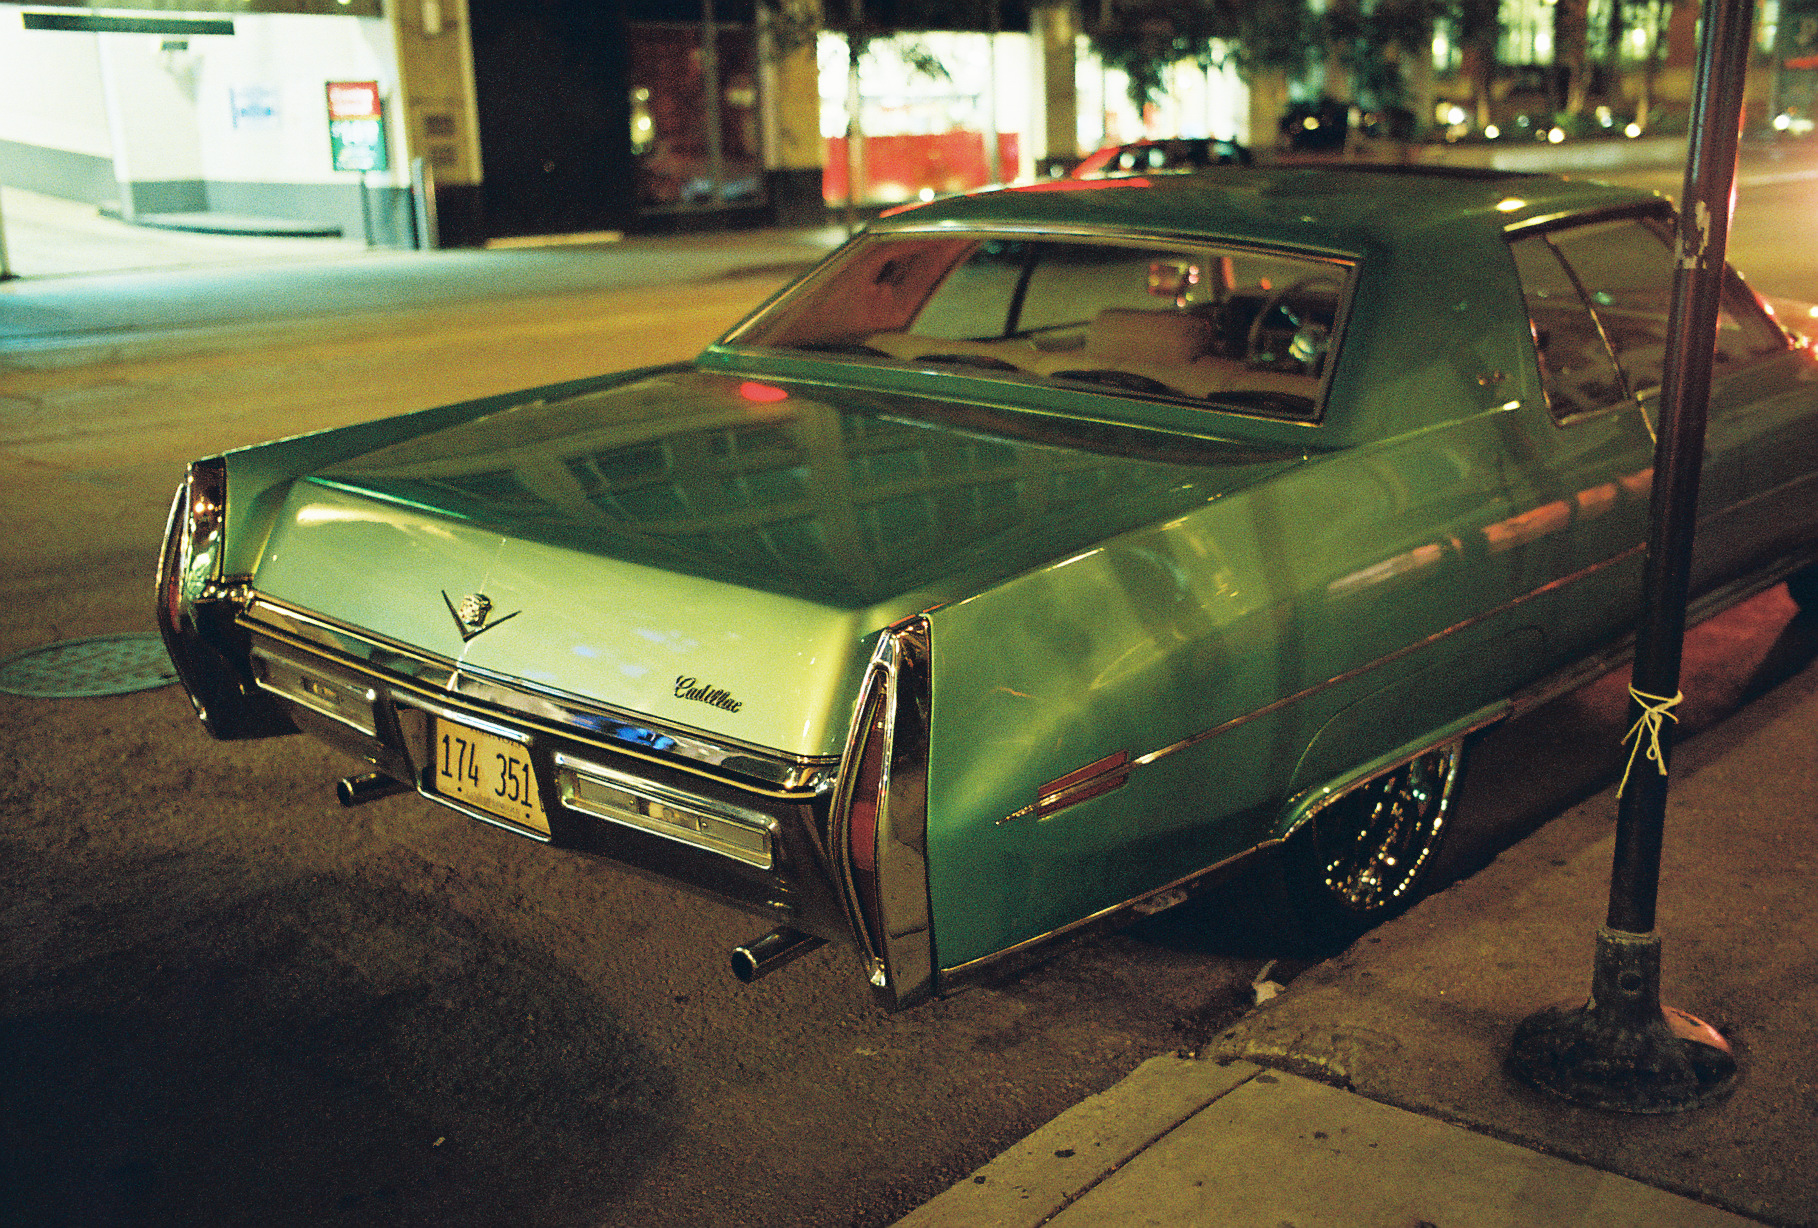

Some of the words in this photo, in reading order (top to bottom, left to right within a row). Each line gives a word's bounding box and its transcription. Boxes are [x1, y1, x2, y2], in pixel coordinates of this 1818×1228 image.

[674, 675, 743, 713] Cadillac
[441, 733, 479, 788] 174
[494, 752, 533, 809] 351
